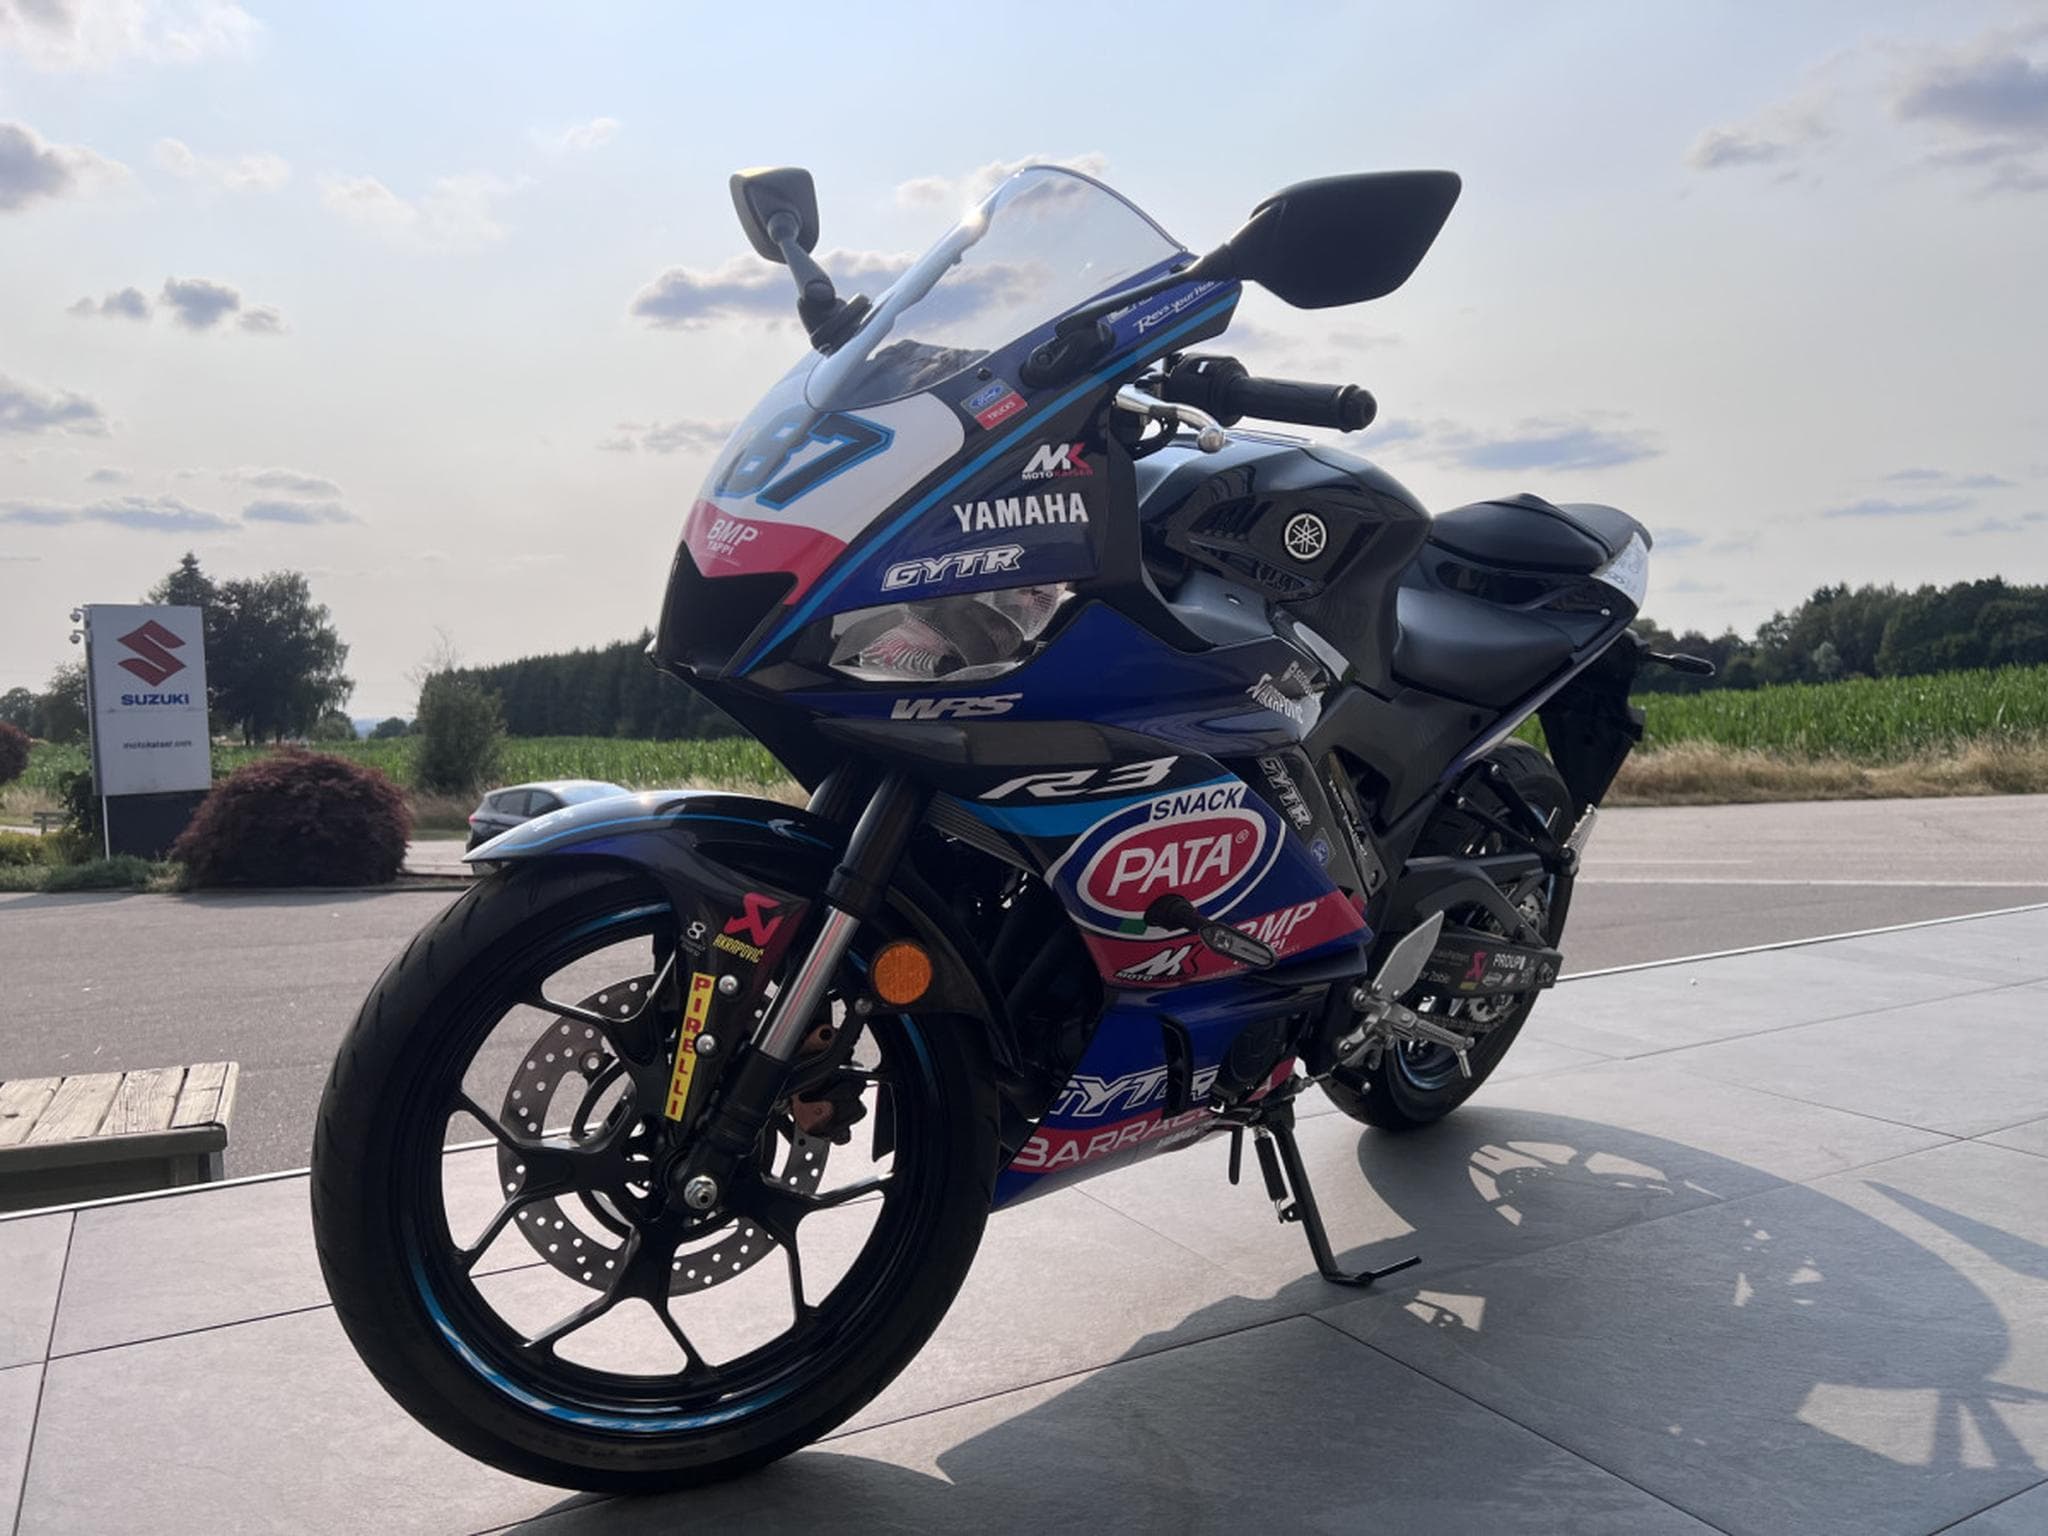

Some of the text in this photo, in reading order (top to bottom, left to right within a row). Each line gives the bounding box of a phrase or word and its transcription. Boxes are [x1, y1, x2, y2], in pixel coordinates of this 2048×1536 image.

[713, 403, 896, 512] 87
[706, 518, 759, 547] BMP
[952, 492, 1090, 533] YAMAHA
[881, 544, 1025, 592] GYTR
[120, 693, 191, 706] SUZUKI
[890, 693, 1023, 720] WRS
[978, 755, 1180, 799] R3
[1152, 786, 1242, 821] SNACK
[1106, 833, 1233, 897] PATA
[669, 974, 712, 1117] PIRELLI
